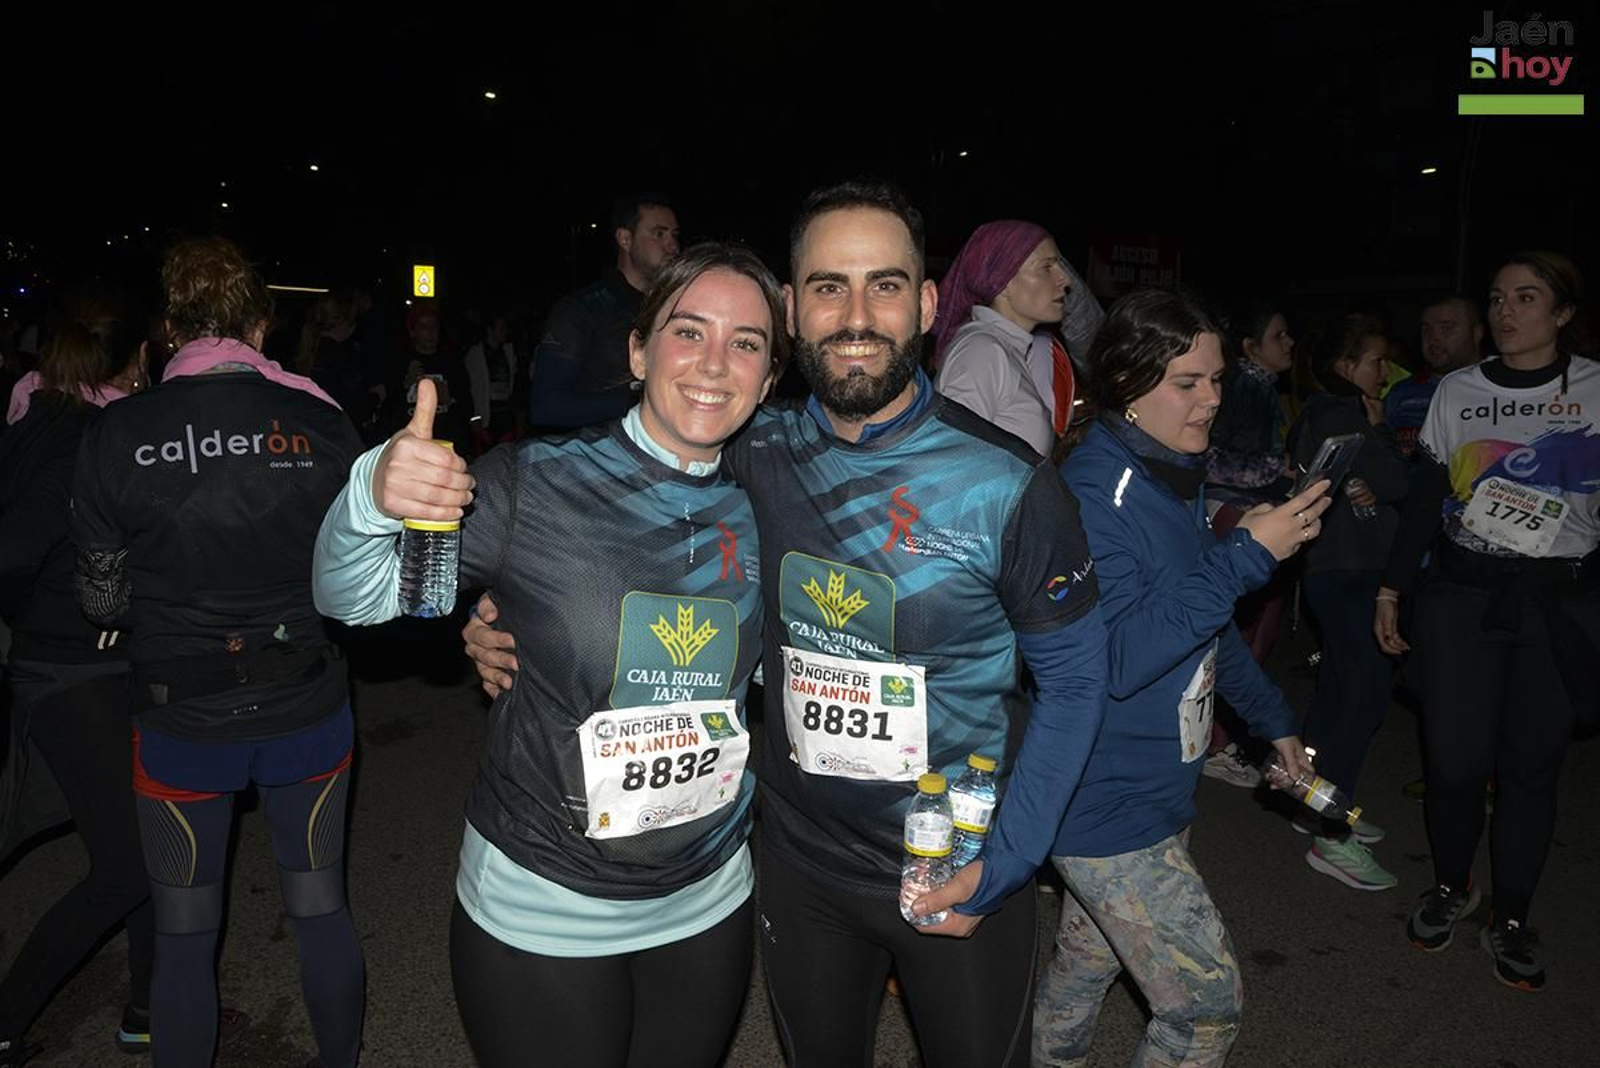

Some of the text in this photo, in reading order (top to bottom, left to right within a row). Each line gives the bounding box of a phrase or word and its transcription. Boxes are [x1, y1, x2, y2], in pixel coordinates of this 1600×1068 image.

[1460, 394, 1582, 425] calderón
[134, 419, 311, 474] calderón
[269, 460, 293, 469] desde
[1485, 501, 1545, 531] 1775
[789, 620, 885, 654] CAJA RURAL
[626, 668, 724, 688] CAJA RURAL
[791, 678, 871, 705] SAN ANTÓN
[804, 666, 850, 685] NOCHE
[852, 674, 871, 689] DE
[651, 685, 695, 702] JAÉN
[619, 718, 674, 738] NOCHE
[676, 716, 694, 730] DE
[802, 700, 893, 742] 8831
[600, 740, 637, 758] SAN
[641, 730, 699, 753] ANTÓN
[621, 747, 721, 792] 8832
